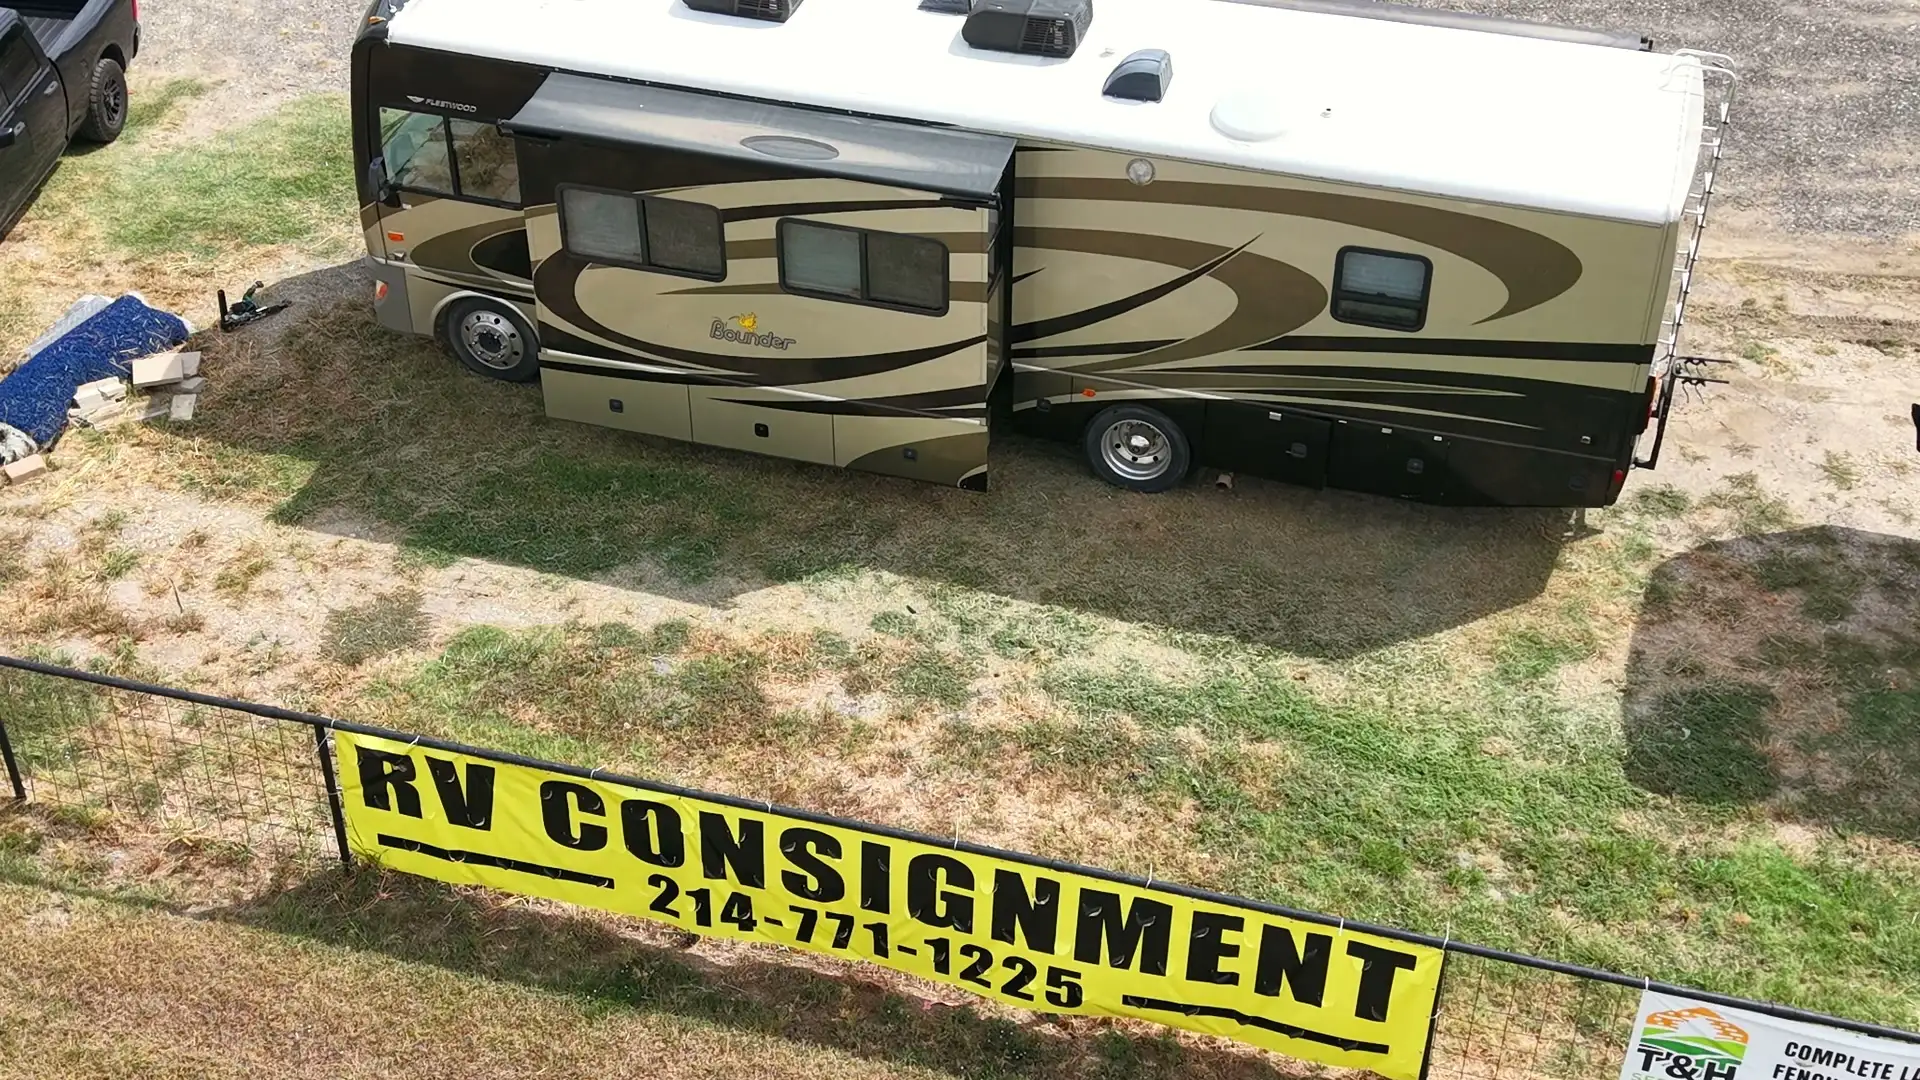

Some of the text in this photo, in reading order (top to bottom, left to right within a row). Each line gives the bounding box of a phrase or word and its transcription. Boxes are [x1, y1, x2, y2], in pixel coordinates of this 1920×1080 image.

[710, 319, 797, 350] Bounder
[354, 744, 1418, 1023] RV CONSIGNMENT
[647, 873, 1083, 1009] 214-771-1225
[1784, 1041, 1894, 1080] COMPLETE
